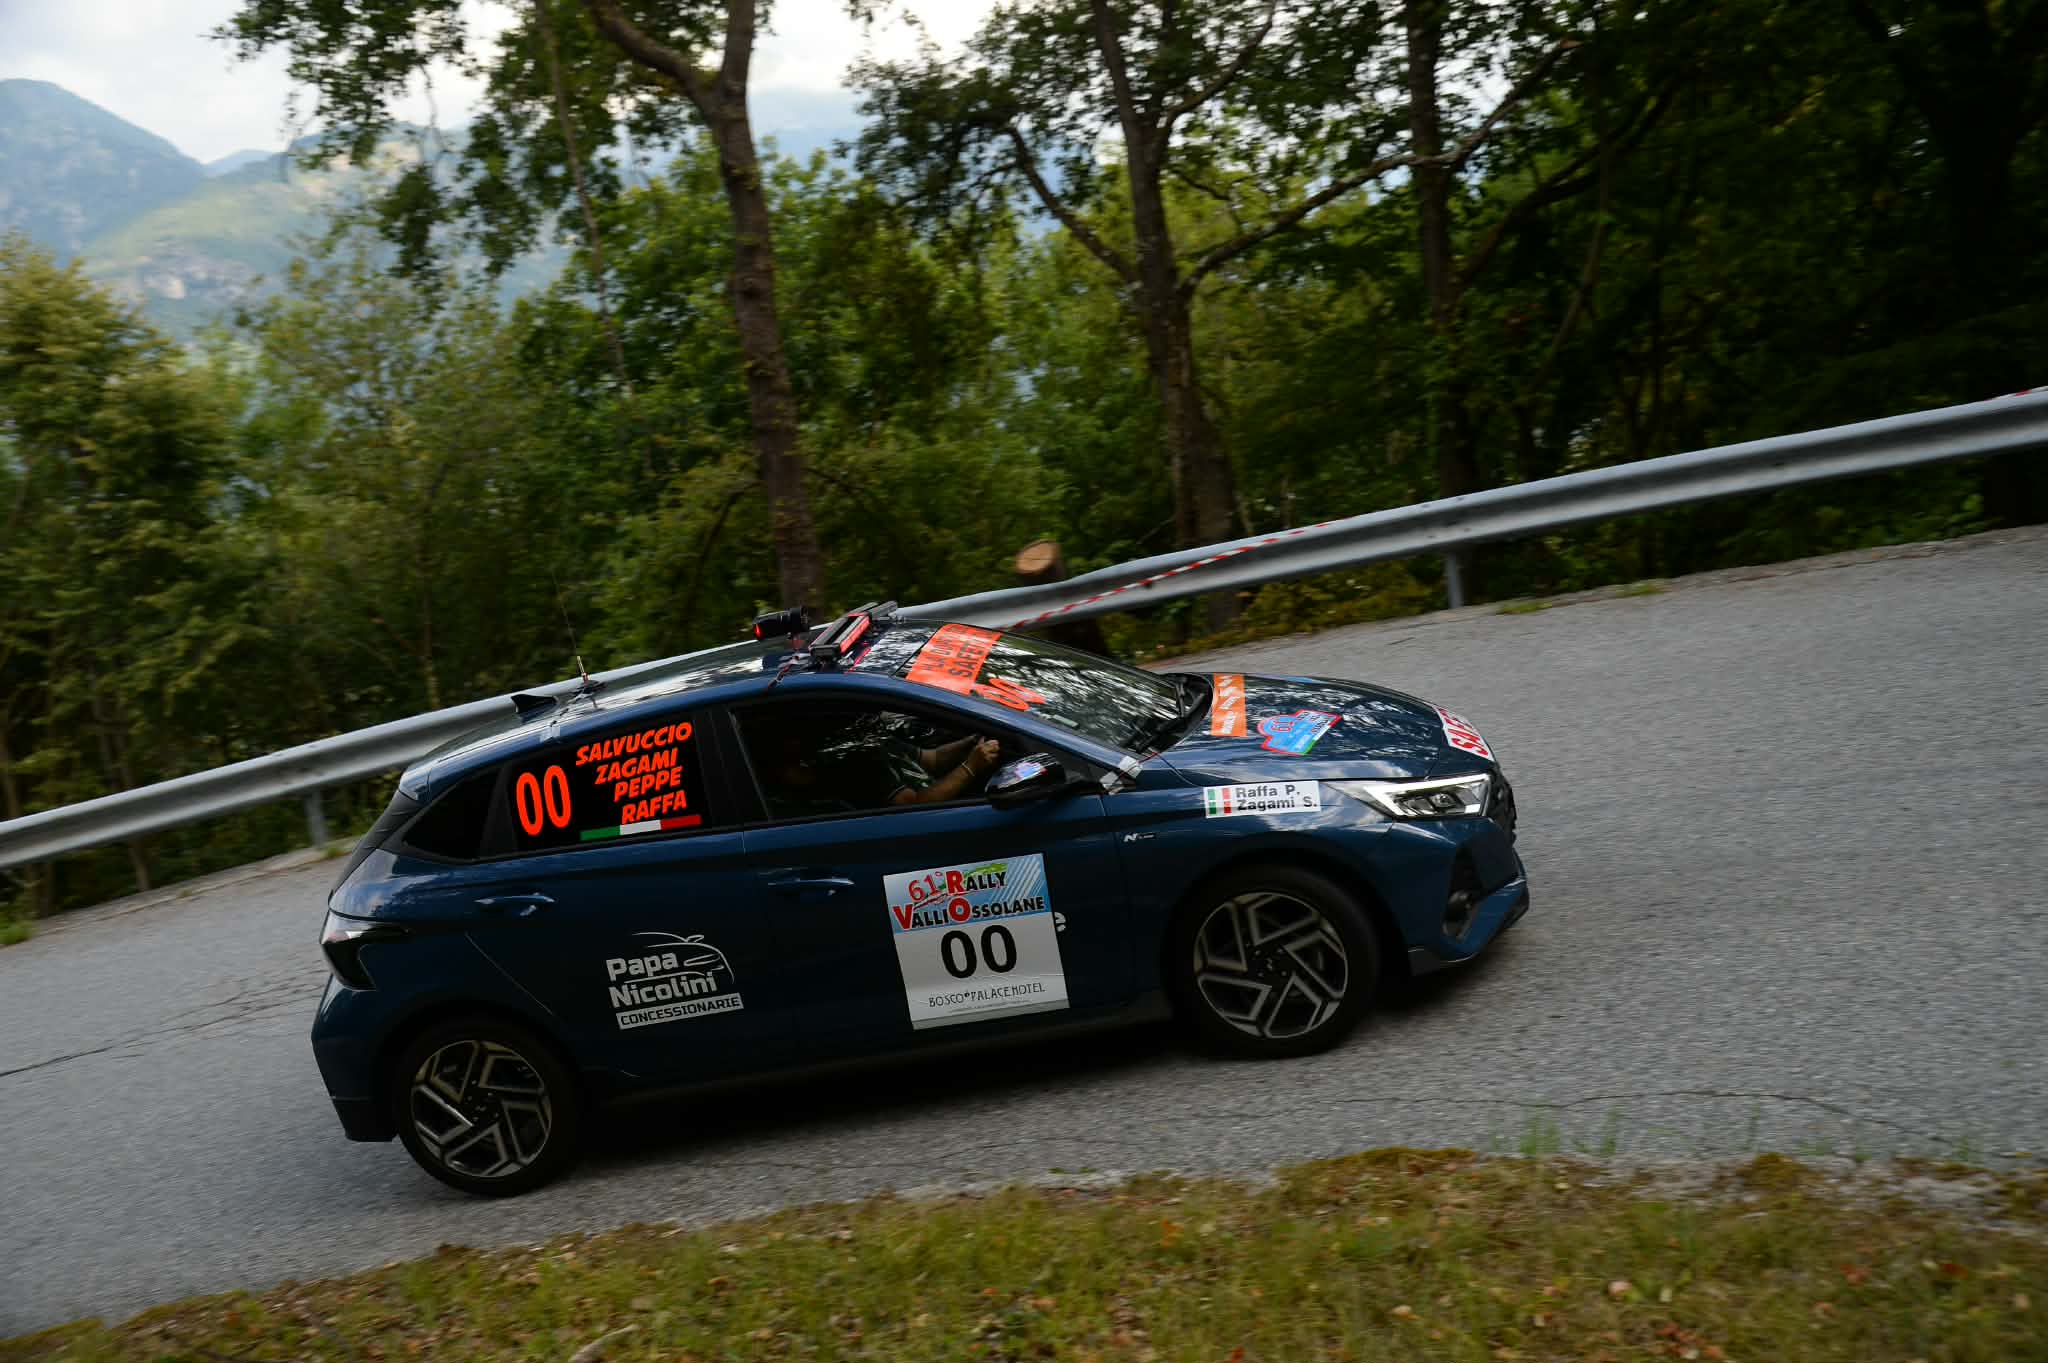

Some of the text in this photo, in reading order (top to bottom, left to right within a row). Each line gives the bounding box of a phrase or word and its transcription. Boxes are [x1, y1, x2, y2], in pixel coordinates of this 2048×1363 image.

[575, 722, 693, 766] SALVUCCIO
[595, 748, 678, 785] ZAGAMI
[516, 765, 571, 835] 00
[613, 766, 683, 802] PEPPE
[1235, 784, 1300, 798] Raffa P.
[621, 790, 687, 824] RAFFA
[1237, 796, 1318, 811] Zagami S.
[945, 870, 1007, 895] RALLY
[606, 952, 679, 982] Papa
[940, 924, 1017, 979] 00
[608, 971, 718, 1008] Nicolini
[928, 993, 964, 1008] BOSCO
[1011, 982, 1046, 996] HOTEL
[620, 997, 741, 1026] CONCESSIONARIE
